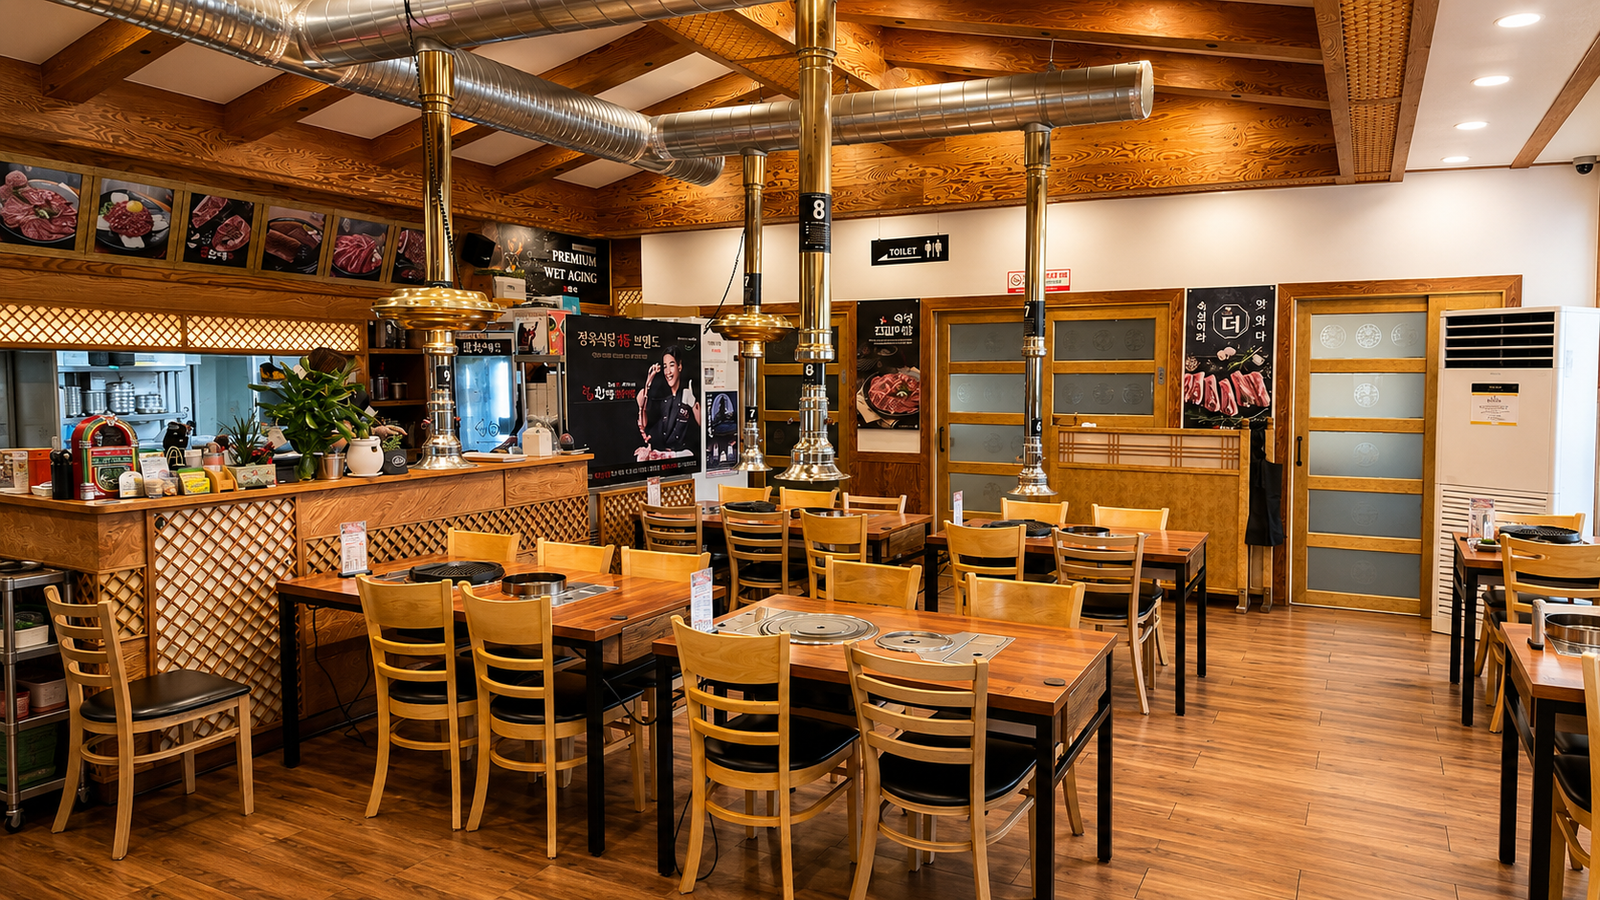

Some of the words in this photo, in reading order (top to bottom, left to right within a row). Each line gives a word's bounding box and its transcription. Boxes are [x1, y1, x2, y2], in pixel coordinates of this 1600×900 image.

[812, 199, 826, 220] 8
[889, 247, 917, 256] TOILET
[552, 249, 597, 268] PREMIUM
[543, 266, 566, 280] WET
[567, 269, 598, 284] AGING
[1221, 315, 1240, 334] 더
[443, 369, 451, 382] 9
[805, 363, 815, 376] 8
[749, 408, 756, 419] 7
[1035, 421, 1042, 433] 6
